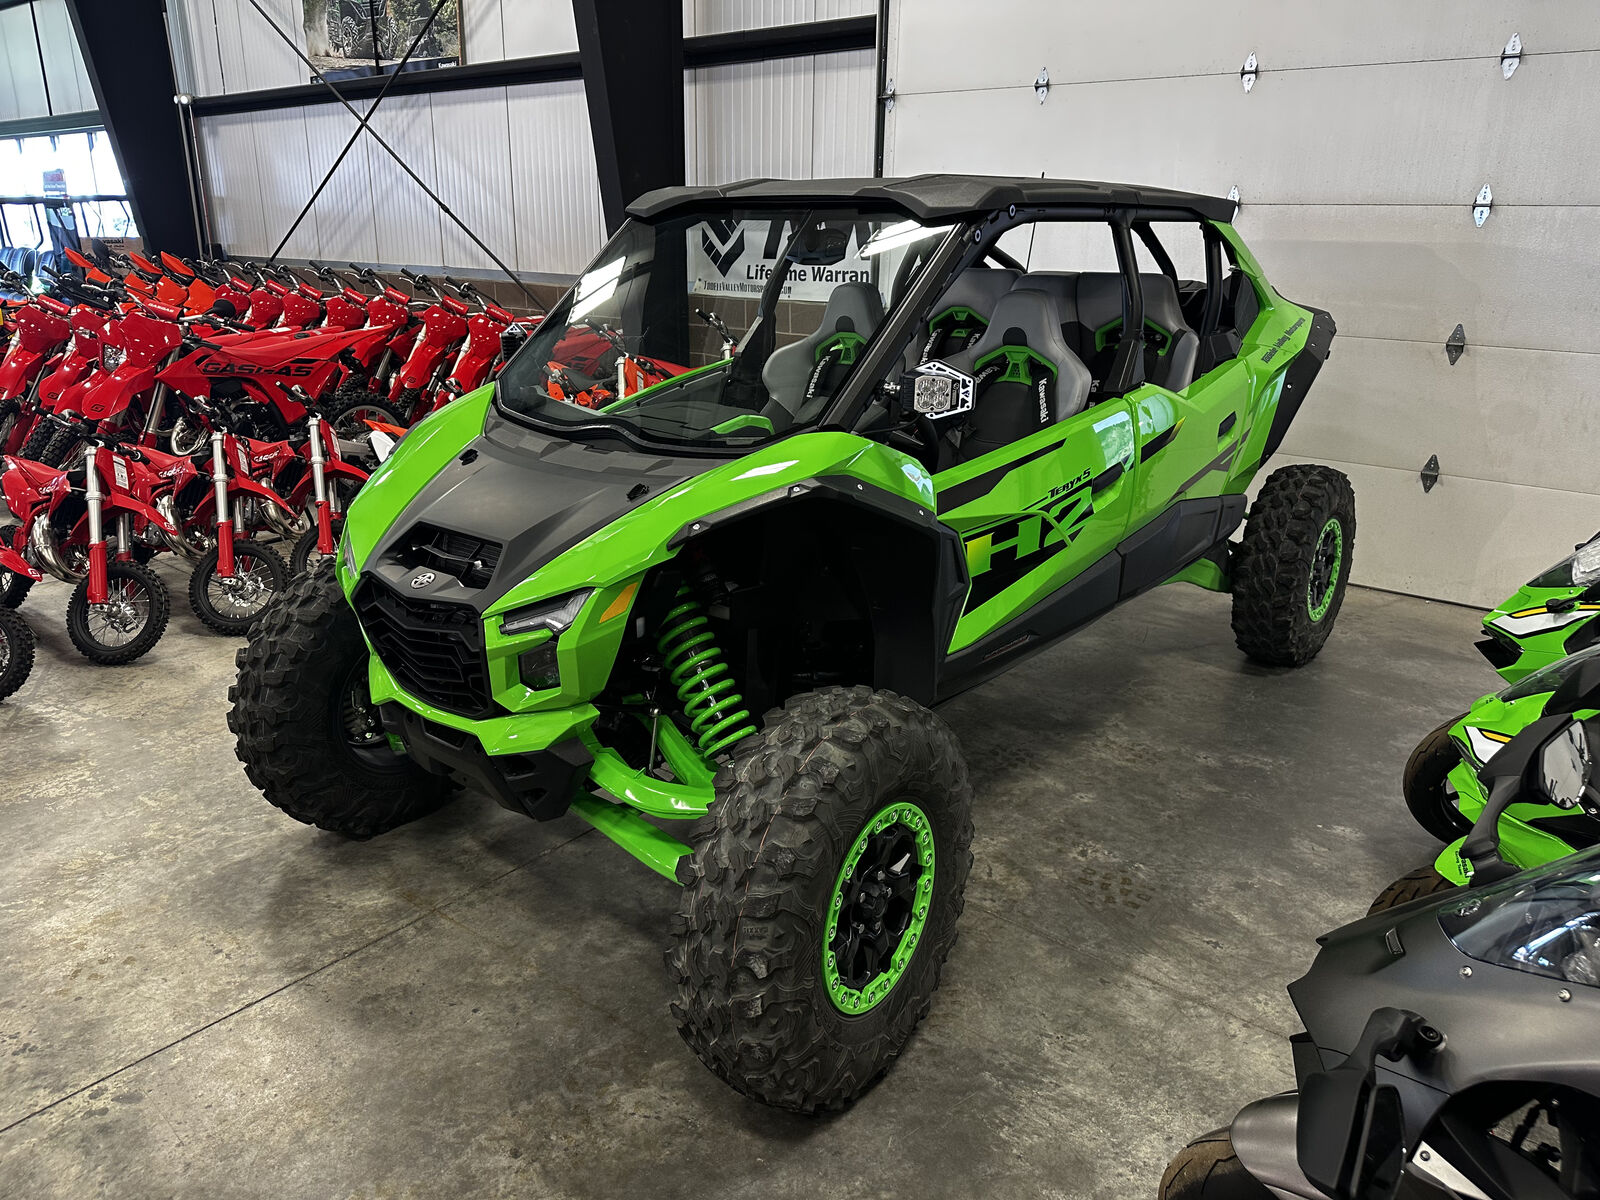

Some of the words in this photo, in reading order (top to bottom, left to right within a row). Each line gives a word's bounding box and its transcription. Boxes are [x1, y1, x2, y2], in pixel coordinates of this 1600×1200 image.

[746, 265, 807, 282] Lifeme
[806, 355, 831, 399] Kawasaki
[1038, 377, 1050, 424] Kawasaki
